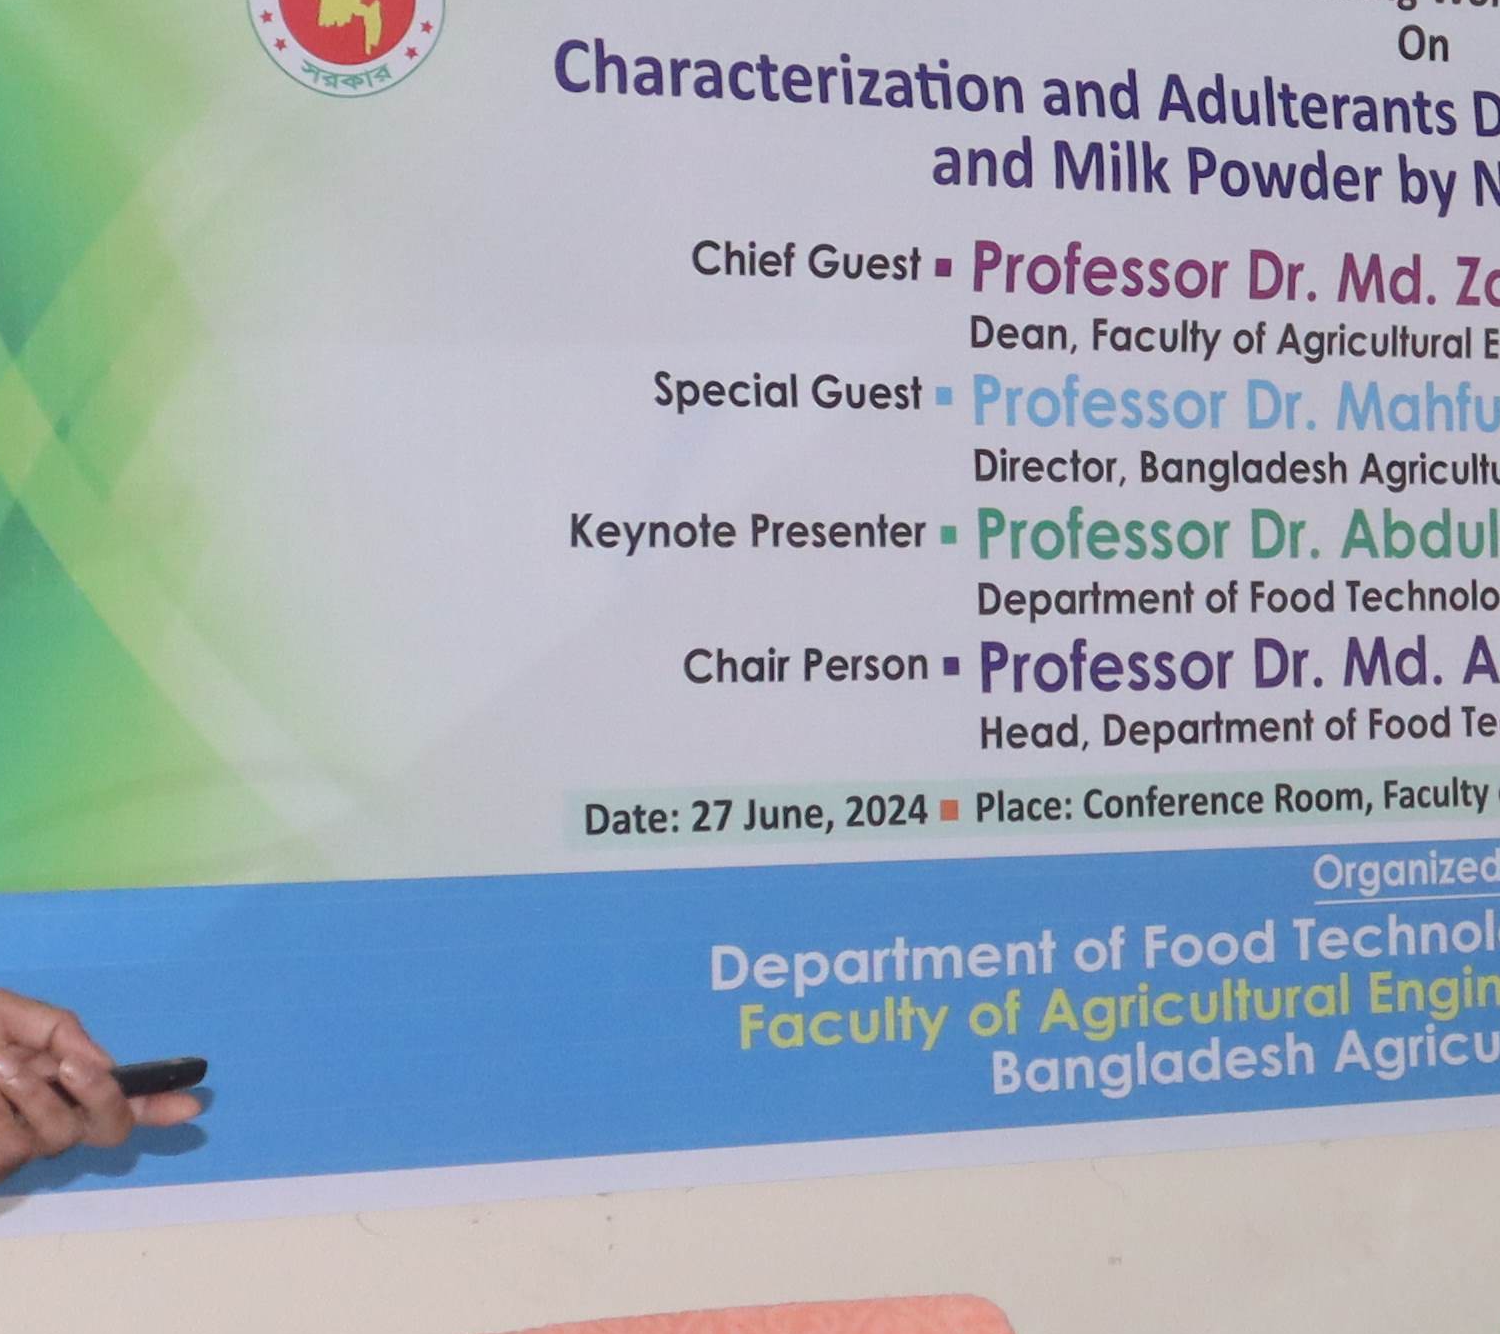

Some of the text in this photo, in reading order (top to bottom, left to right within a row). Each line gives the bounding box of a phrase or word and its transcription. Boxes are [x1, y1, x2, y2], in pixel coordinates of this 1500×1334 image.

[1398, 23, 1449, 63] On
[301, 59, 392, 90] সরকার
[555, 39, 1024, 113] Characterization
[1044, 68, 1140, 120] and
[1158, 73, 1457, 136] Adulterants
[933, 135, 1032, 189] and
[1054, 139, 1170, 194] Milk
[1188, 146, 1382, 202] Powder
[1398, 152, 1456, 219] by
[692, 239, 796, 278] Chief
[808, 243, 921, 282] Guest
[974, 240, 1229, 299] Professor
[1249, 248, 1316, 302] Dr.
[1338, 252, 1436, 306] Md.
[971, 314, 1077, 354] Dean,
[1093, 317, 1221, 361] Faculty
[1233, 320, 1266, 356] of
[1276, 323, 1471, 364] Agricultural
[654, 371, 798, 414] Special
[812, 373, 922, 411] Guest
[974, 373, 1227, 429] Professor
[1248, 378, 1315, 431] Dr.
[974, 447, 1126, 486] Director,
[1141, 450, 1347, 492] Bangladesh
[571, 512, 736, 557] Keynote
[751, 513, 926, 549] Presenter
[978, 506, 1230, 560] Professor
[1252, 508, 1319, 559] Dr.
[684, 647, 790, 685] Chair
[804, 647, 928, 682] Person
[981, 639, 1234, 693] Professor
[1255, 637, 1323, 689] Dr.
[1344, 634, 1442, 687] Md.
[981, 714, 1088, 750] Head,
[1104, 709, 1314, 753] Department
[1325, 706, 1356, 742] of
[1369, 705, 1450, 740] Food
[585, 803, 679, 836] Date:
[692, 798, 732, 833] 27
[744, 798, 834, 834] June,
[846, 793, 928, 828] 2024
[977, 790, 1072, 823] Place:
[1084, 785, 1264, 820] Conference
[1275, 783, 1372, 816] Room,
[1384, 776, 1489, 814] Faculty
[1314, 849, 1500, 897] Organized
[712, 931, 1056, 993] Department
[1075, 925, 1125, 972] of
[1145, 920, 1274, 968] Food
[741, 995, 949, 1050] Faculty
[969, 992, 1021, 1038] of
[1040, 976, 1350, 1039] Agricultural
[993, 1033, 1314, 1094] Bangladesh
